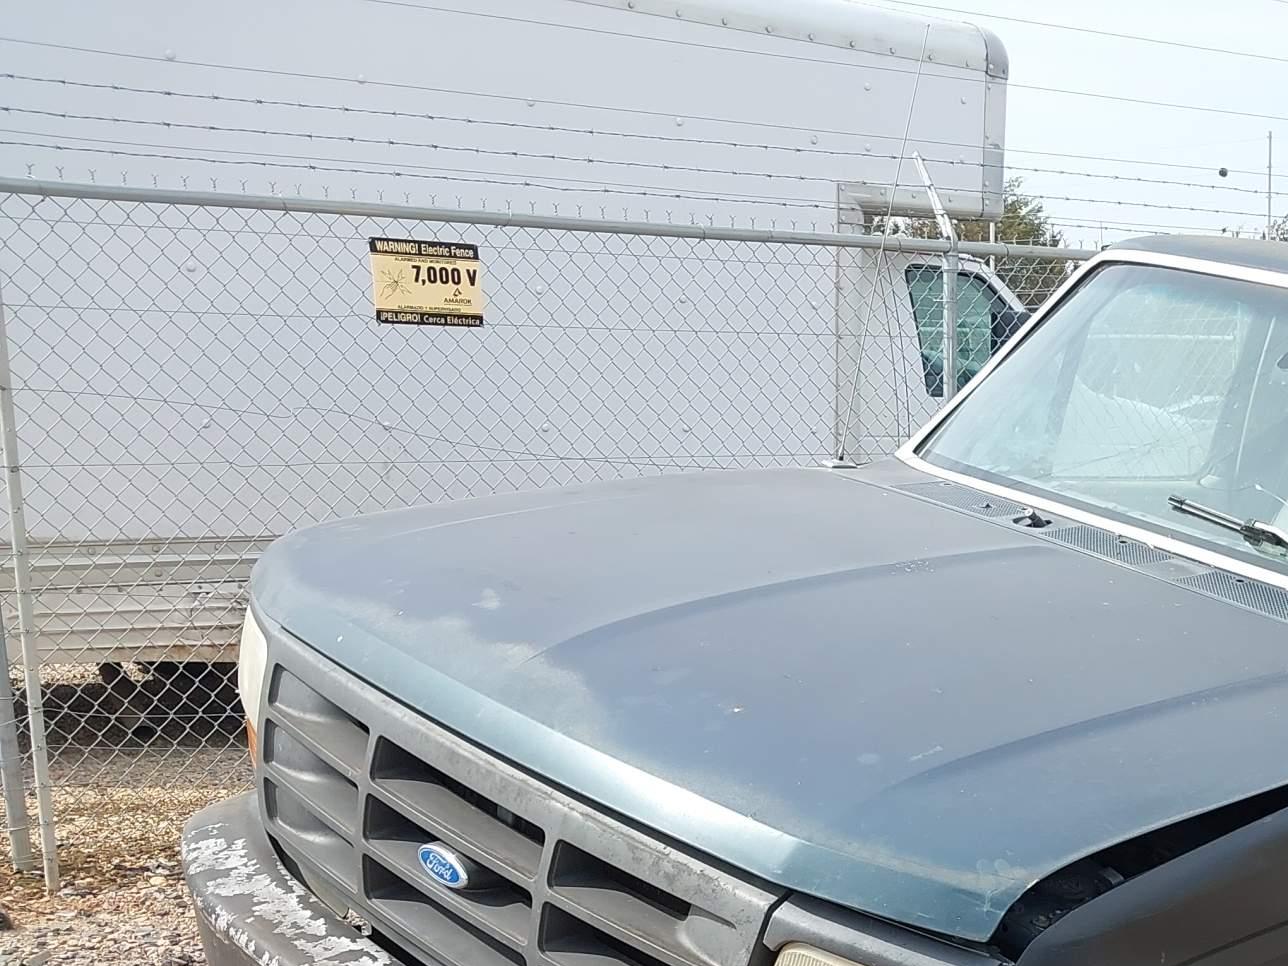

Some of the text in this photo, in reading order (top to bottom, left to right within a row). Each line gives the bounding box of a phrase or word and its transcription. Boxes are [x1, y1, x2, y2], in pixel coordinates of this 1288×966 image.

[375, 241, 474, 258] WARNING! Electric Fence
[411, 265, 477, 287] 7,000 V
[423, 315, 445, 323] Cerca
[446, 314, 480, 325] Eléctrica
[426, 853, 453, 880] Ford
